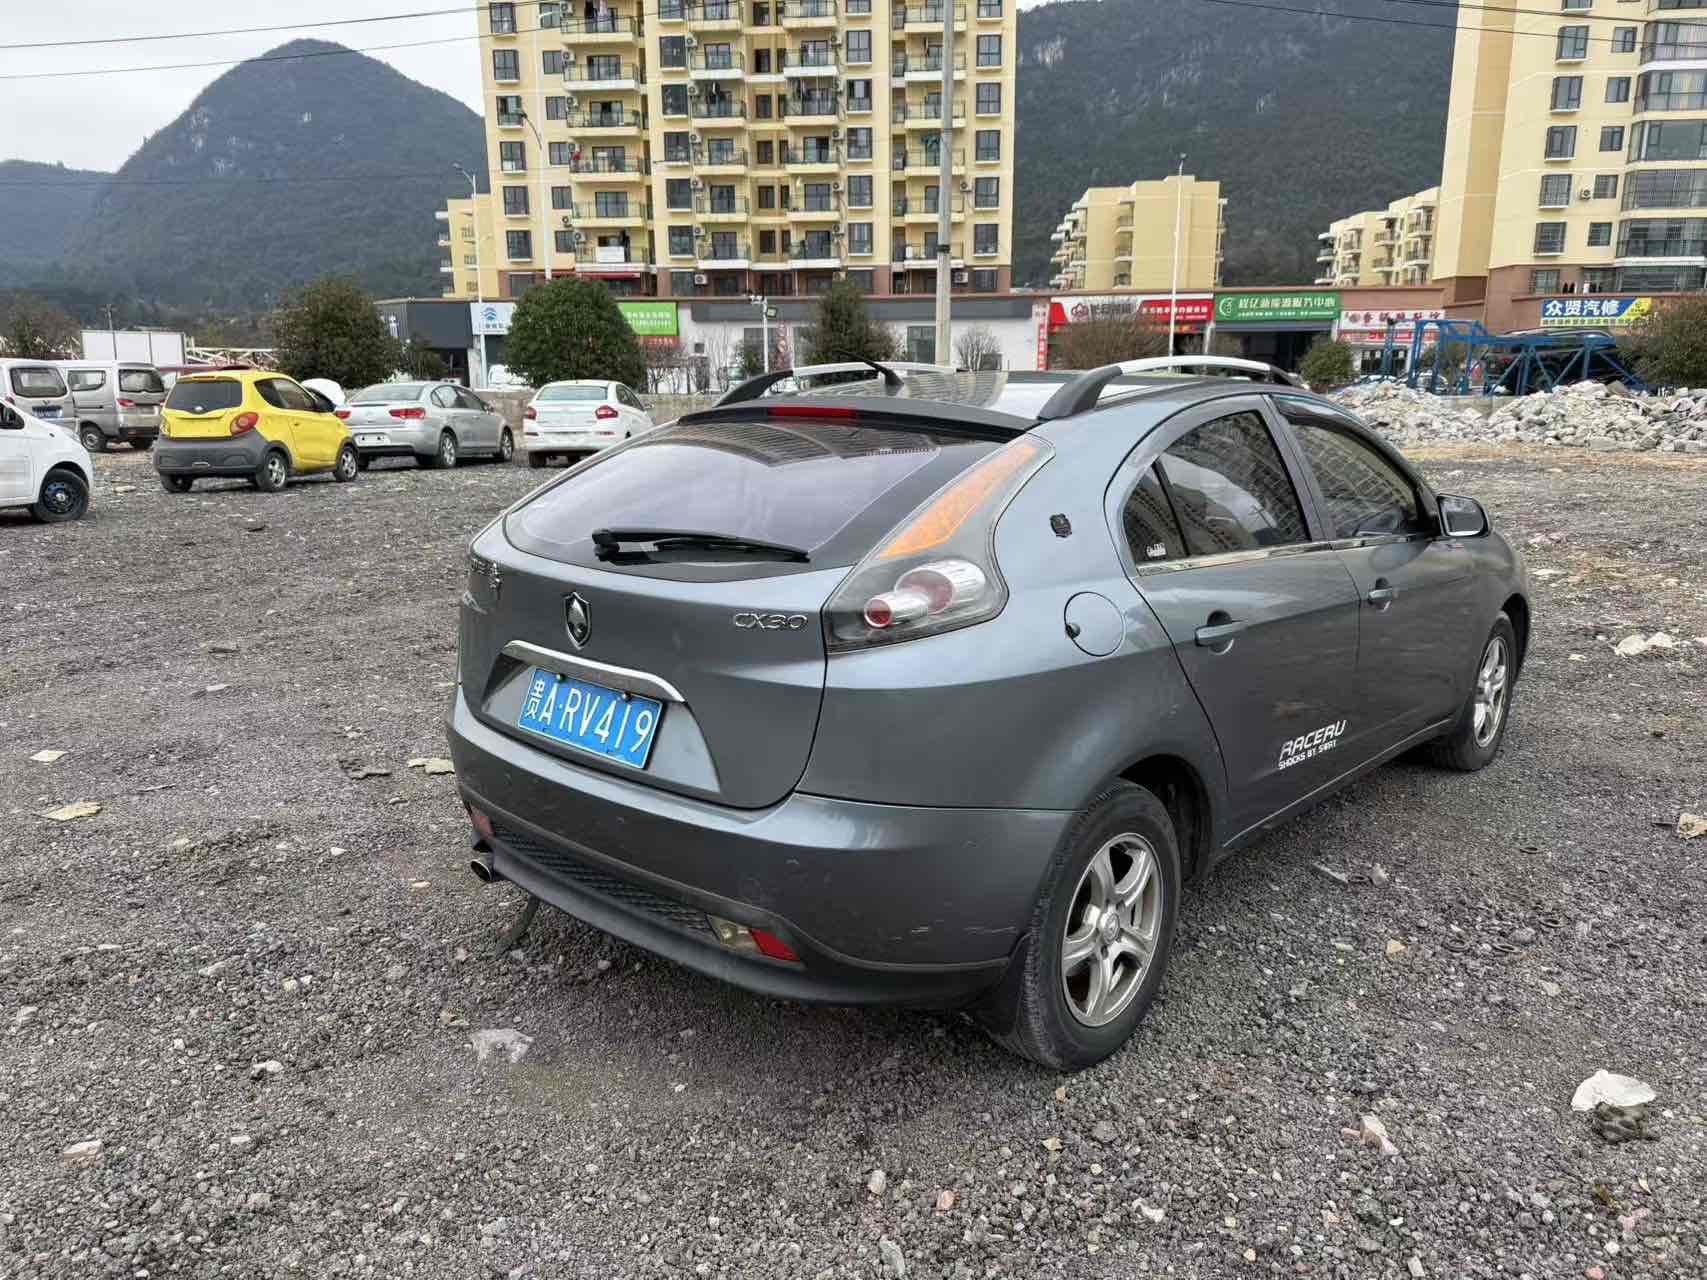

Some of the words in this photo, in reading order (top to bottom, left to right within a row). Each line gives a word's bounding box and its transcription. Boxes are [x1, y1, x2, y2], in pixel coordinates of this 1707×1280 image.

[1545, 300, 1620, 316] 众贤汽修
[733, 613, 808, 629] CX30
